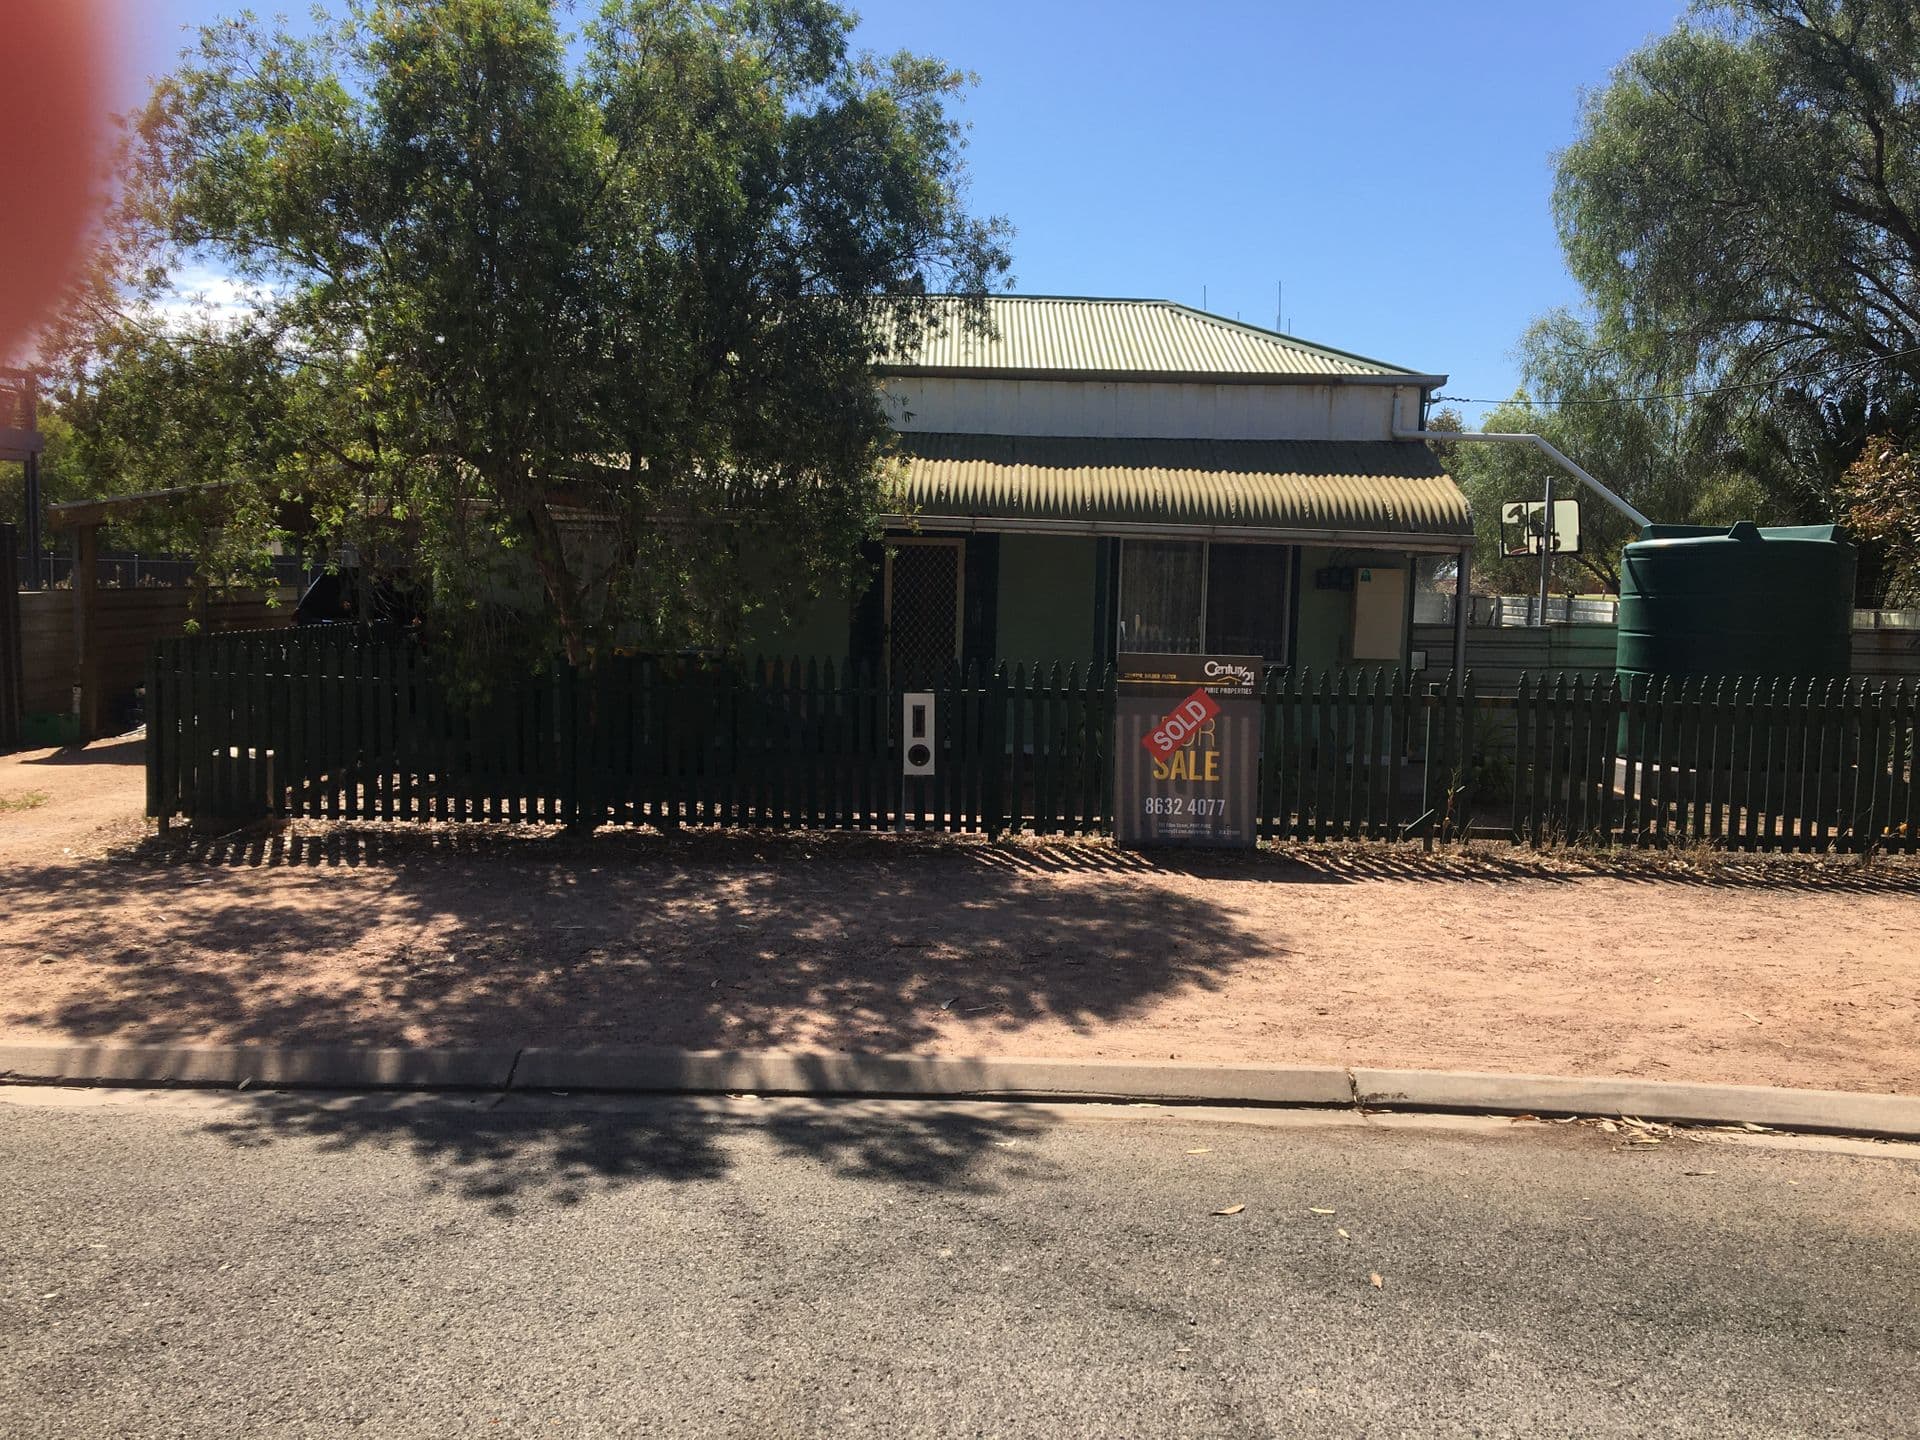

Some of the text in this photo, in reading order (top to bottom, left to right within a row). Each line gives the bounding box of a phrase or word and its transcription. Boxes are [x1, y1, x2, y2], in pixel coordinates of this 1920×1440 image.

[1204, 660, 1254, 686] Century 21
[1219, 687, 1253, 695] PROPERTIES
[1153, 700, 1207, 751] SOLD
[1153, 750, 1220, 782] SALE
[1145, 797, 1226, 816] 8632 4077
